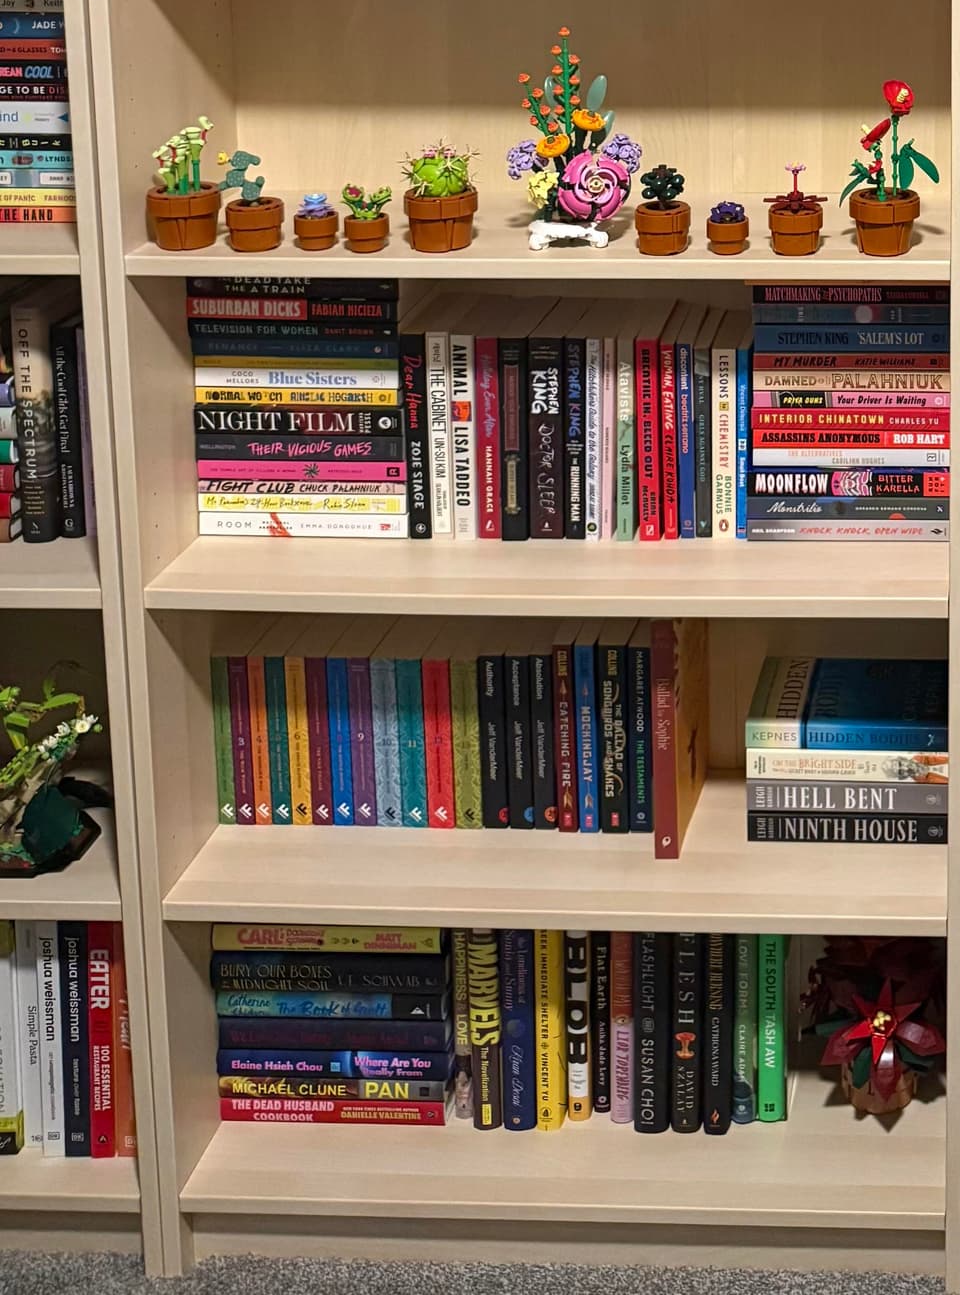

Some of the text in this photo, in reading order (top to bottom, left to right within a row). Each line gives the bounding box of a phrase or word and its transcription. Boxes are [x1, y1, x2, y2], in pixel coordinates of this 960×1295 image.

[24, 66, 54, 78] COOL
[23, 208, 53, 222] HAND
[17, 328, 30, 358] OFF
[20, 366, 32, 392] THE
[268, 371, 357, 385] Blue Sisters
[199, 411, 355, 432] NIGHT FILM
[452, 345, 470, 507] ANIMAL LISA TADDEO
[759, 414, 884, 425] INTERIOR CHINATOWN
[23, 400, 37, 479] SPECTRUM
[755, 474, 829, 494] MOONFLOW
[581, 706, 592, 782] MOCKINGJAY
[752, 733, 797, 741] KEPNES
[784, 787, 897, 810] HELL BENT
[784, 818, 918, 842] NINTH HOUSE
[39, 937, 56, 1041] joshua weissman
[90, 949, 110, 1010] EATER
[764, 941, 776, 1068] THE SOUTH TASH AW
[232, 1082, 347, 1096] MICHAEL CLUNE
[365, 1082, 409, 1098] PAN
[640, 1038, 654, 1126] SUSAN CHOI
